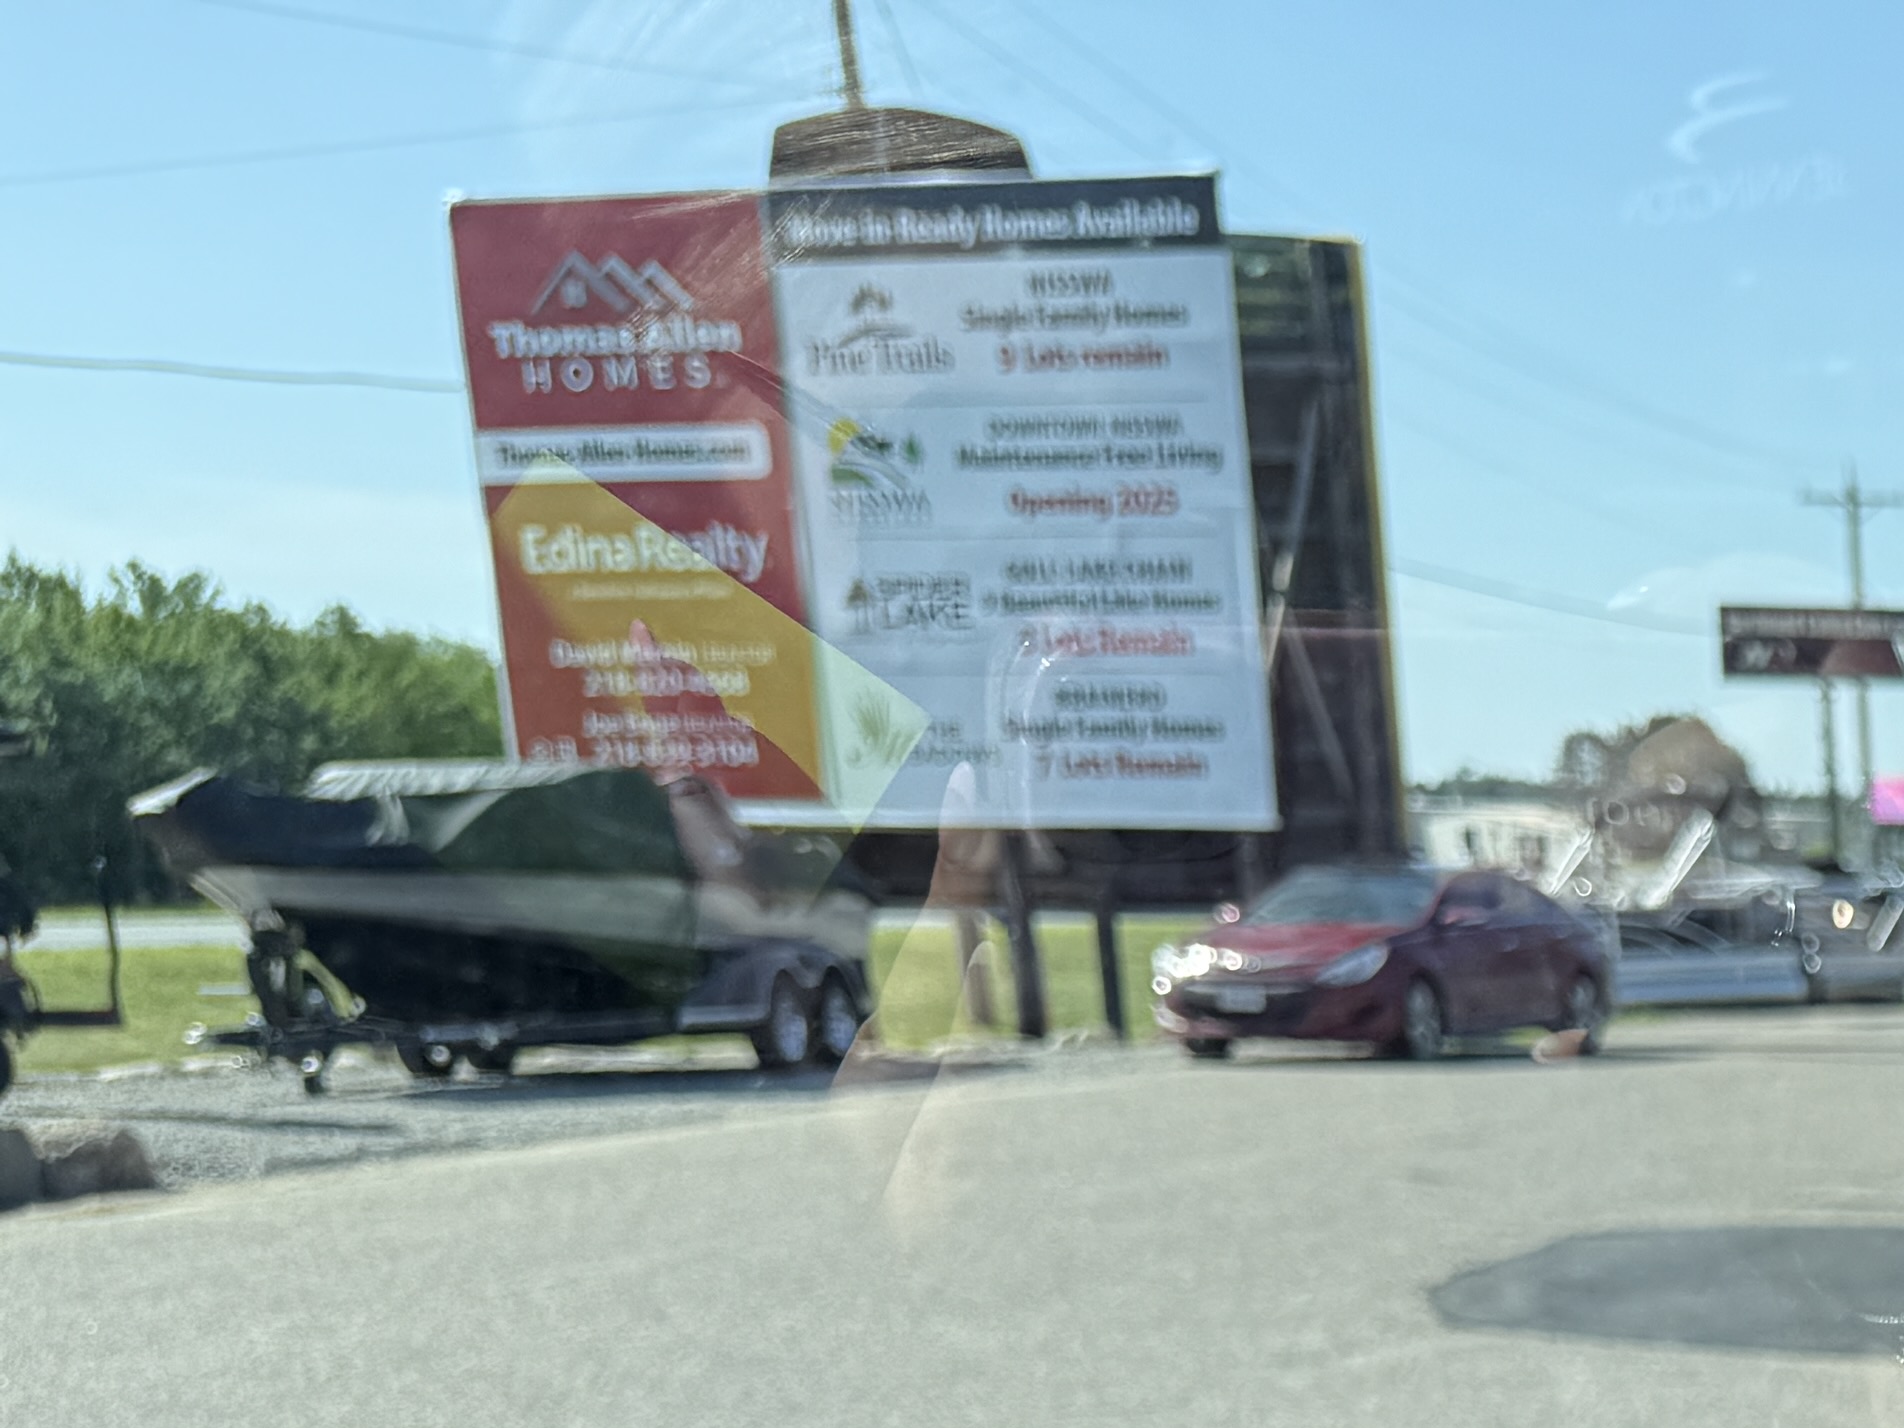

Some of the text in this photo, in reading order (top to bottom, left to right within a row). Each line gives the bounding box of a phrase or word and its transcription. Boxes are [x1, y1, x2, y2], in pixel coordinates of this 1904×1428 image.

[896, 204, 978, 250] Ready
[981, 202, 1069, 242] Homes
[1074, 196, 1200, 238] Available
[488, 312, 743, 358] Thomas Allen
[807, 334, 956, 377] Pine Trails
[520, 354, 712, 393] HOMES
[1007, 482, 1114, 521] Opening
[518, 518, 770, 584] Edina Realty
